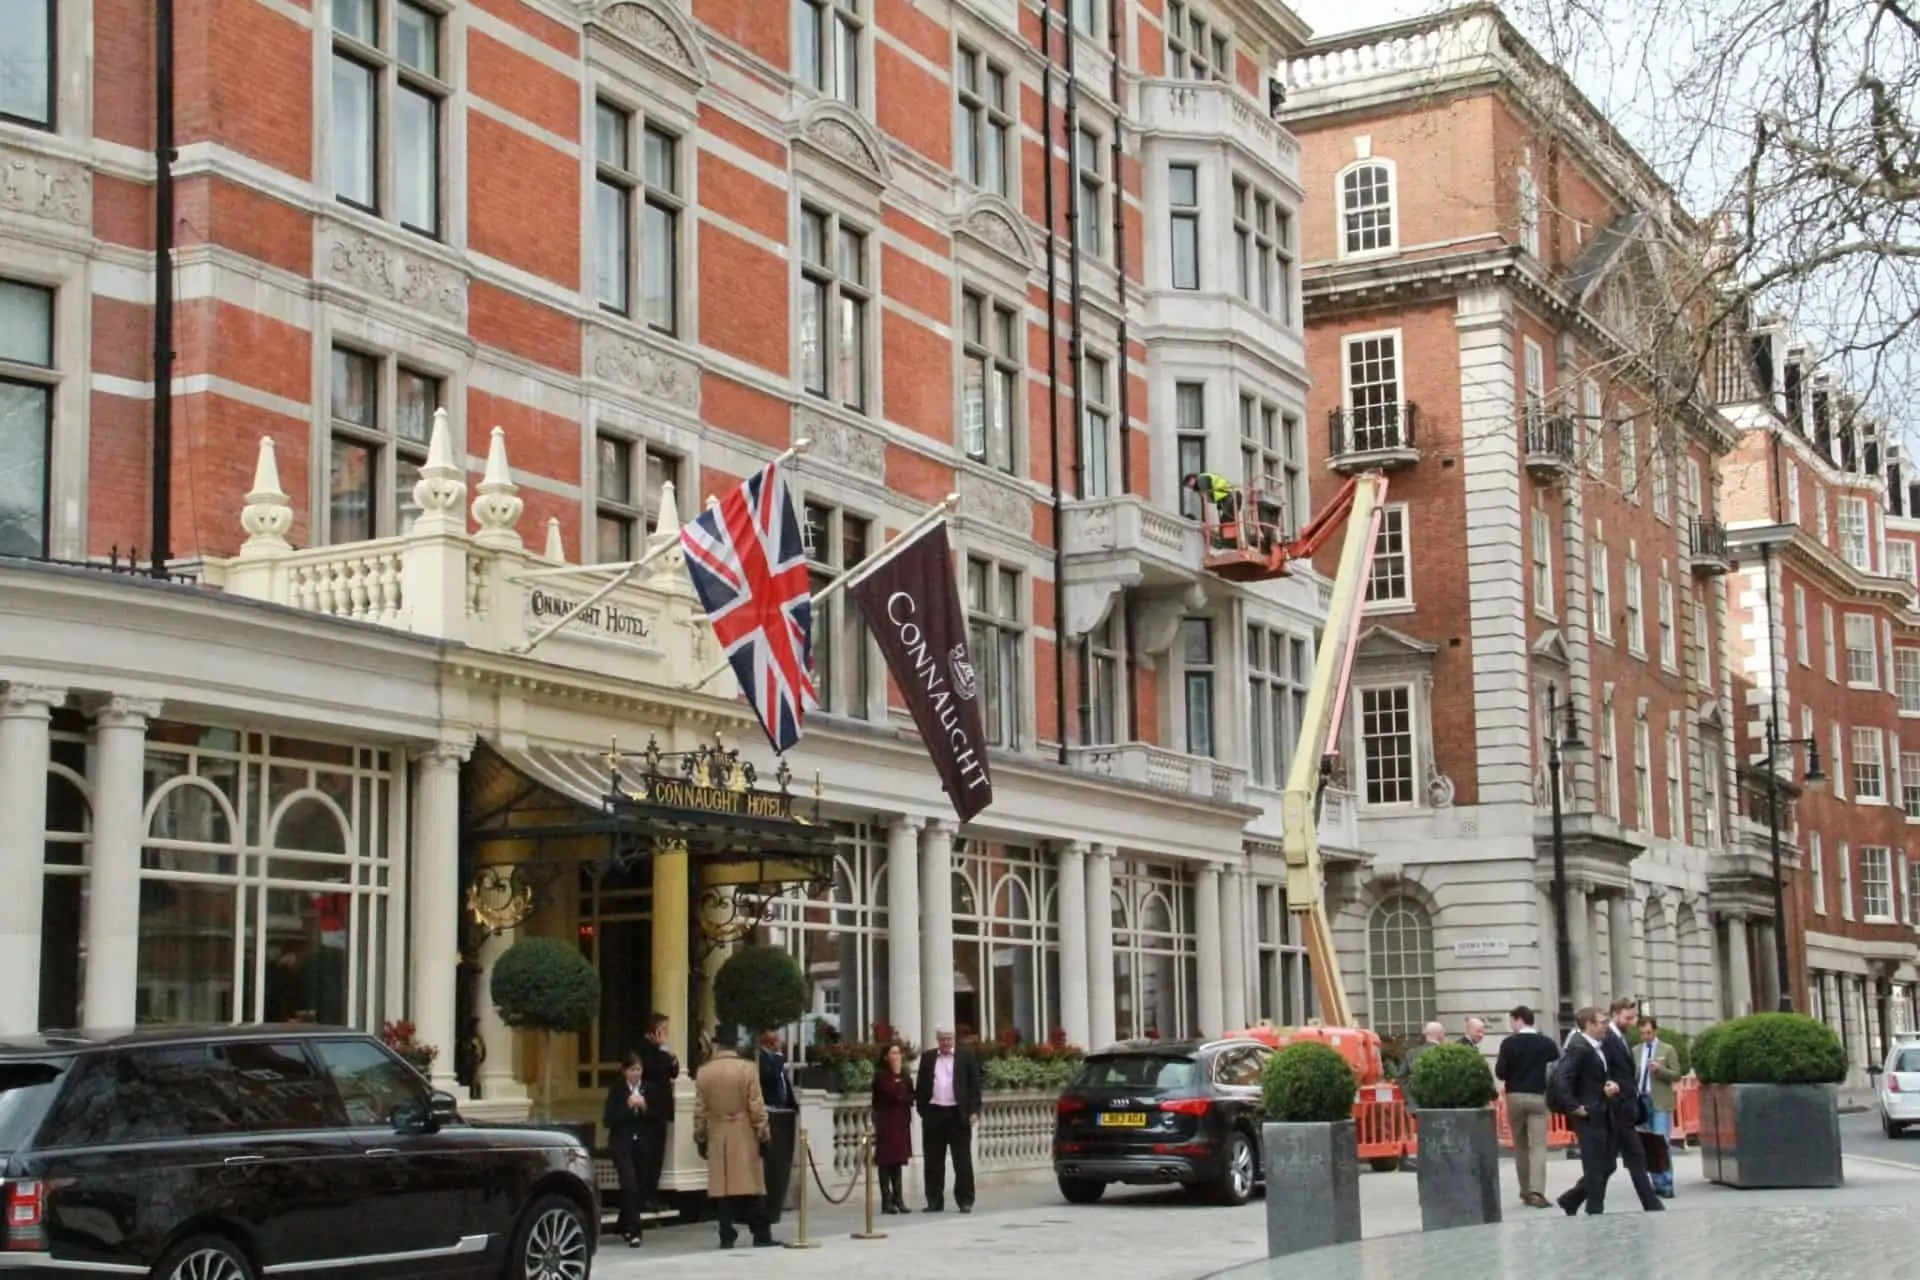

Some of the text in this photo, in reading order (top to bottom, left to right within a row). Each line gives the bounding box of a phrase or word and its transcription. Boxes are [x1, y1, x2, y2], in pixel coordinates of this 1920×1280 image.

[606, 605, 649, 637] HOTEL
[887, 591, 990, 789] CONNAUGHT
[655, 782, 785, 818] CONNAUGHT HOTEL
